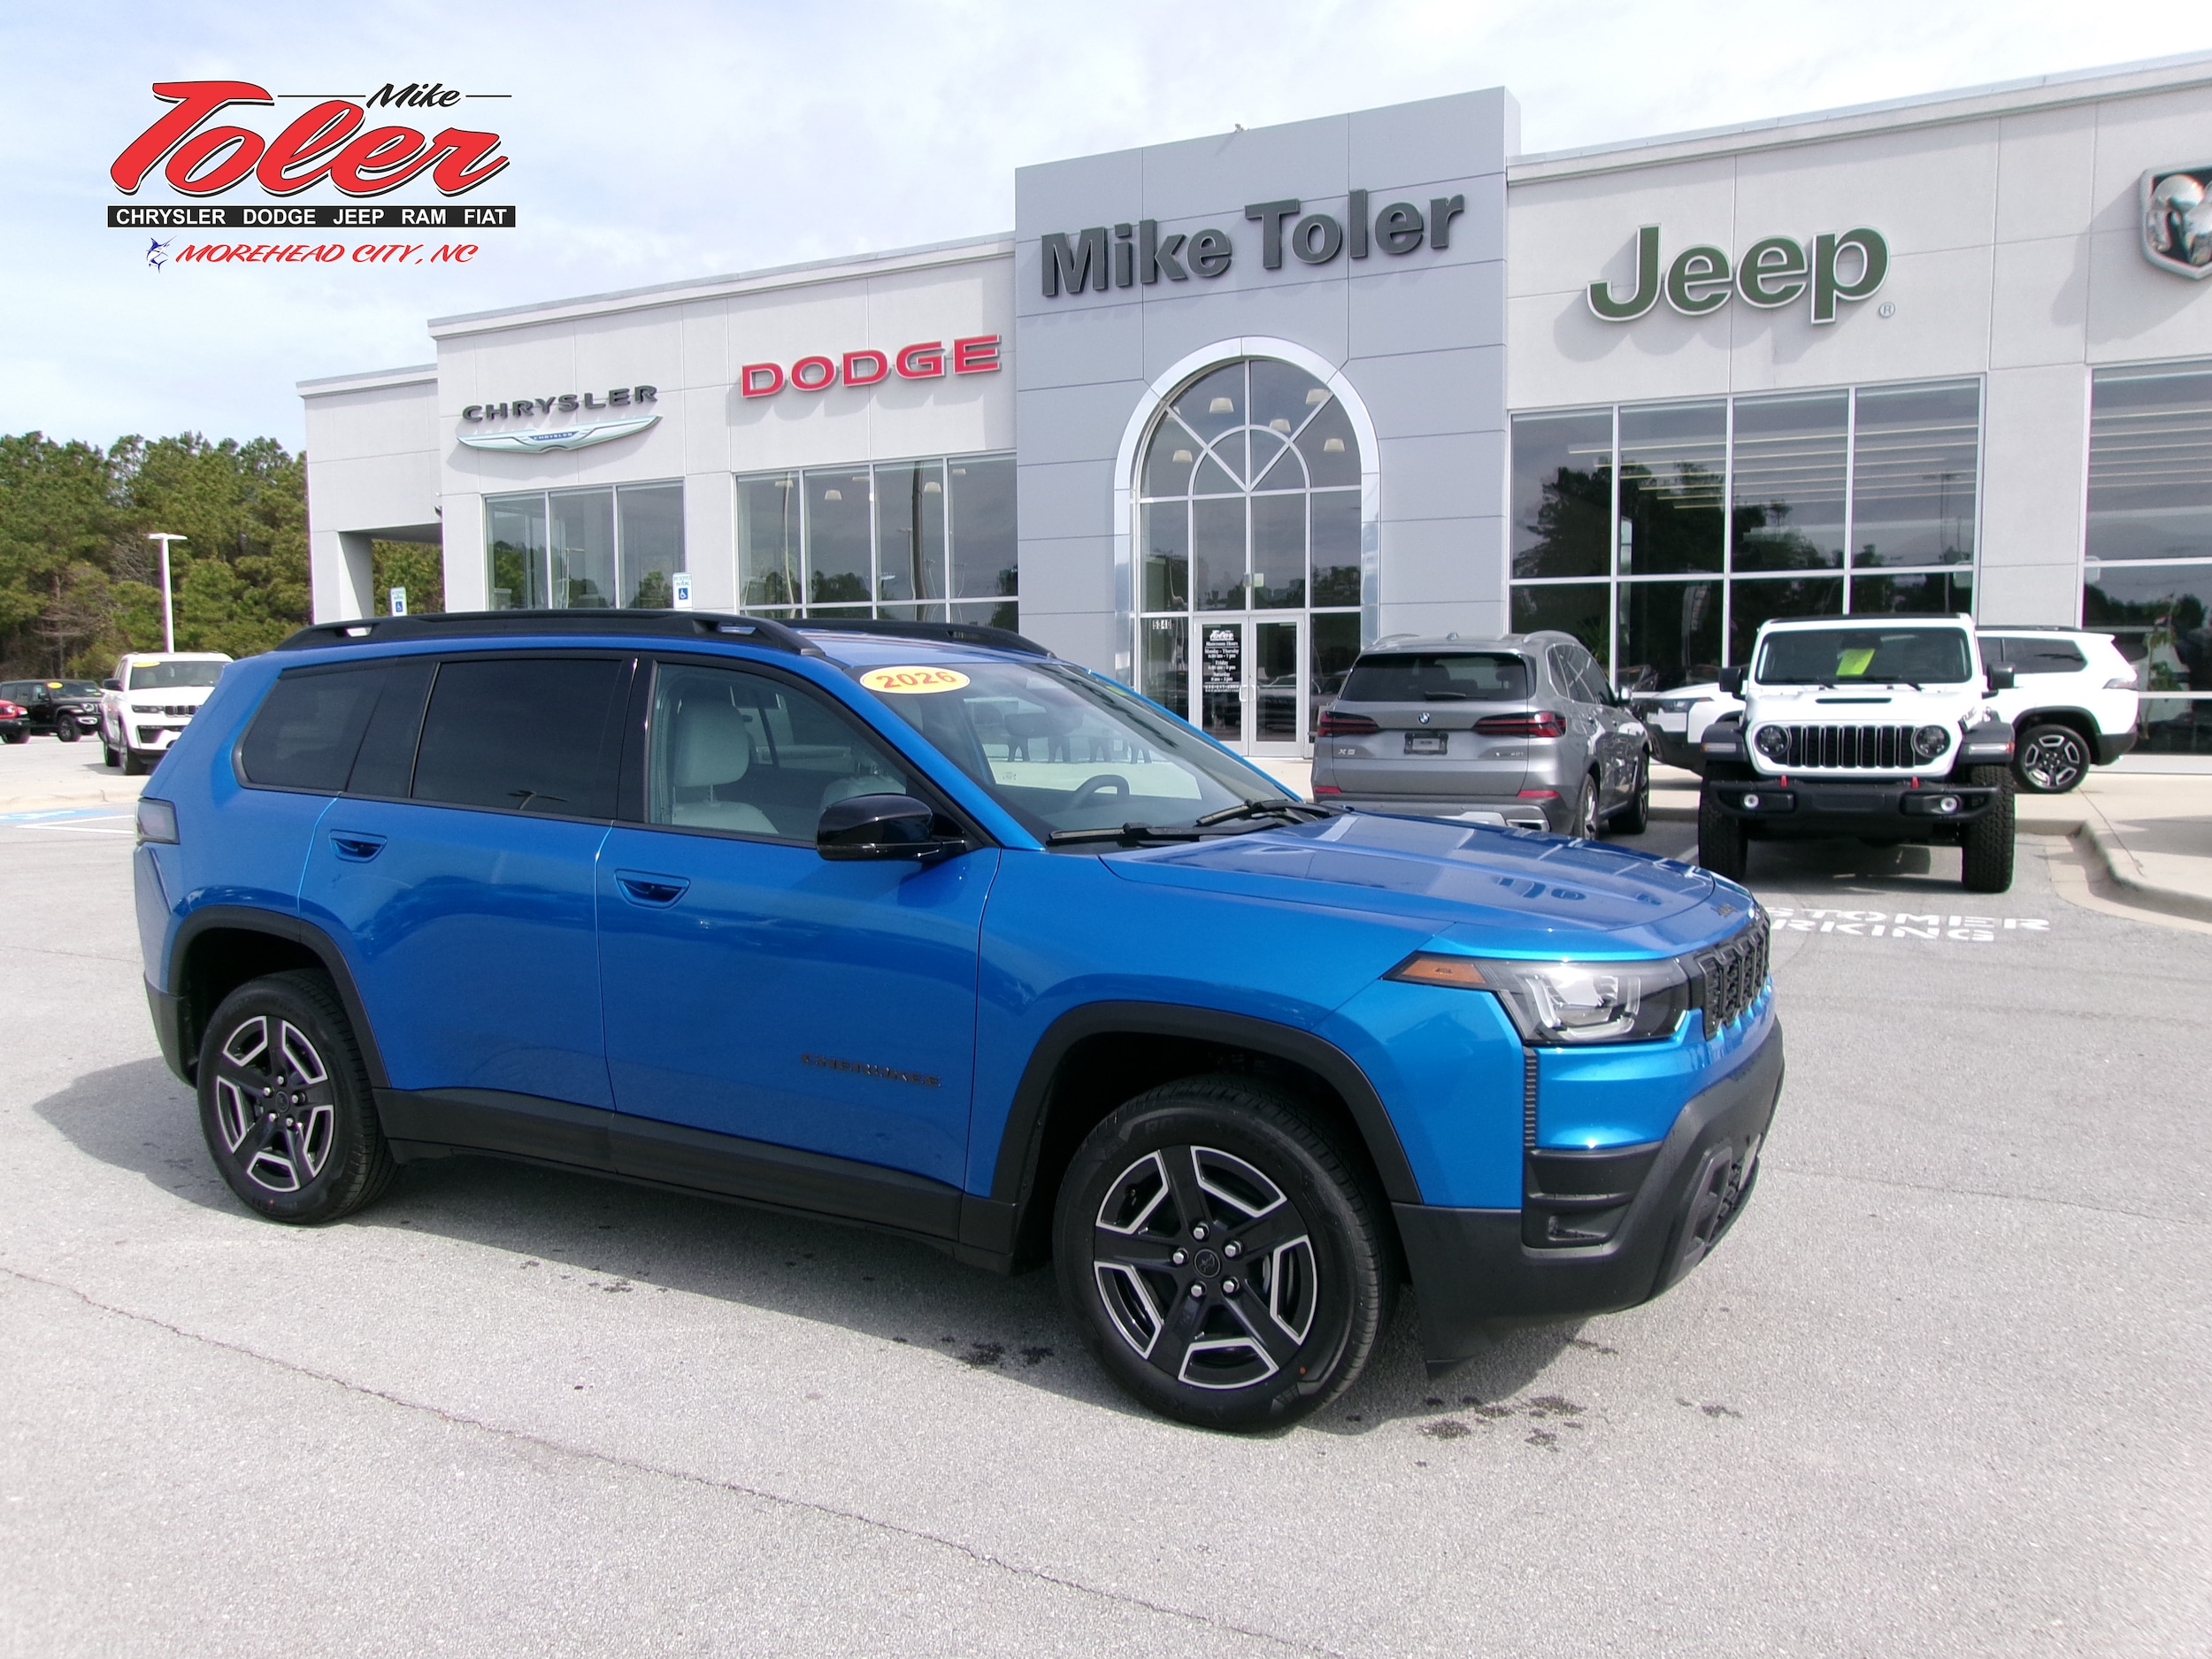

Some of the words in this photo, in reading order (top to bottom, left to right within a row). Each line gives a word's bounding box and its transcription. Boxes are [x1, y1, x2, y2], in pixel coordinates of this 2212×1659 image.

[1041, 219, 1233, 297] Mike
[1244, 188, 1465, 270] Toler
[1586, 223, 1891, 326] Jeep
[741, 334, 1002, 399] DODGE
[462, 384, 658, 423] CHRYSLER
[876, 671, 957, 689] 2026
[1764, 906, 2050, 930] STOMER
[1770, 918, 1994, 941] RKING
